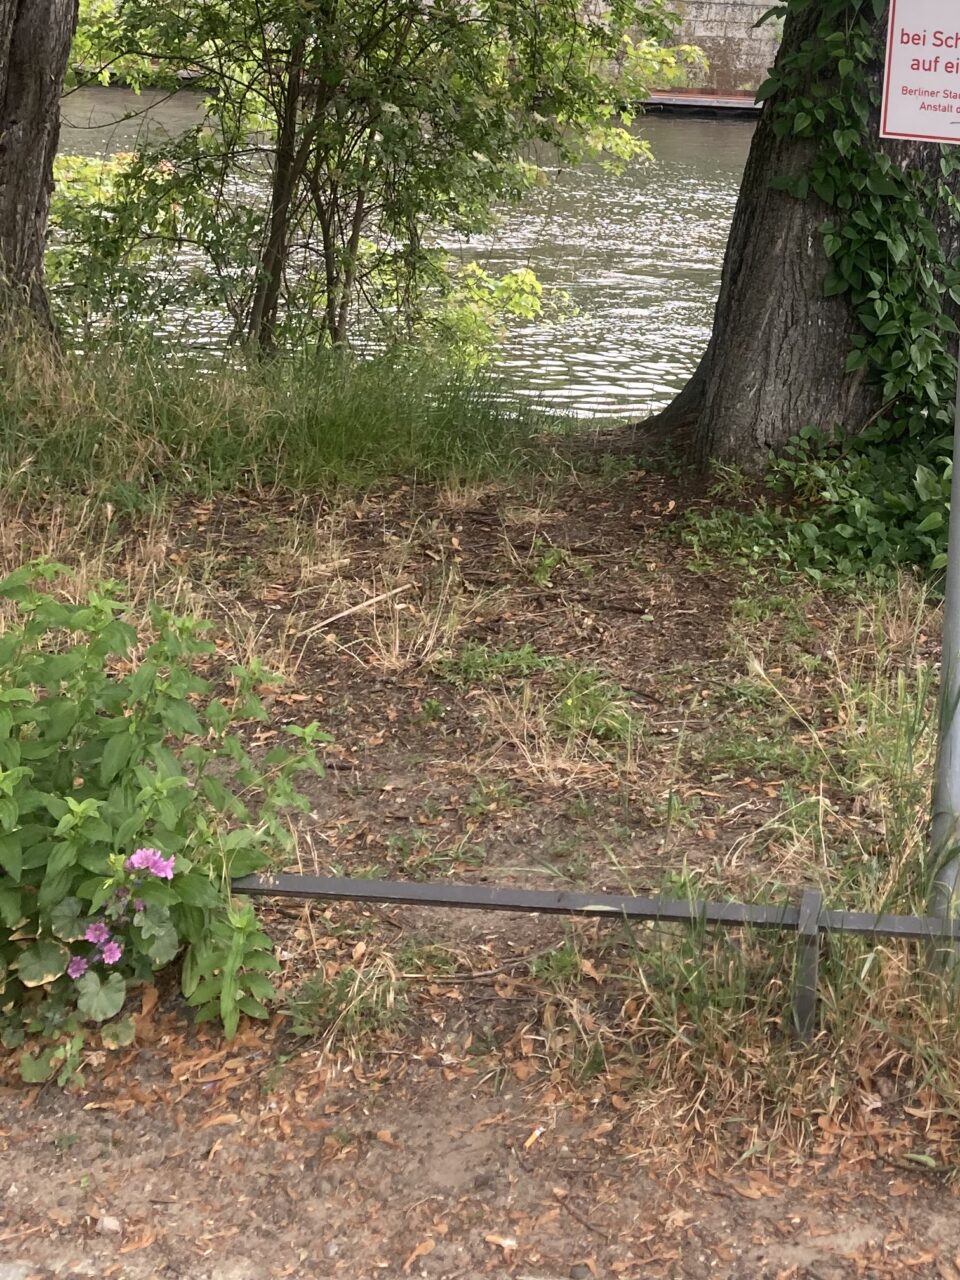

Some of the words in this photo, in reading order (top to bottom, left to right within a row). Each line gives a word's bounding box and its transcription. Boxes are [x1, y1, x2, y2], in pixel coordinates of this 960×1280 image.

[900, 28, 926, 46] bei
[910, 56, 939, 73] auf
[901, 86, 940, 98] Berliner
[919, 102, 953, 114] Anstalt
